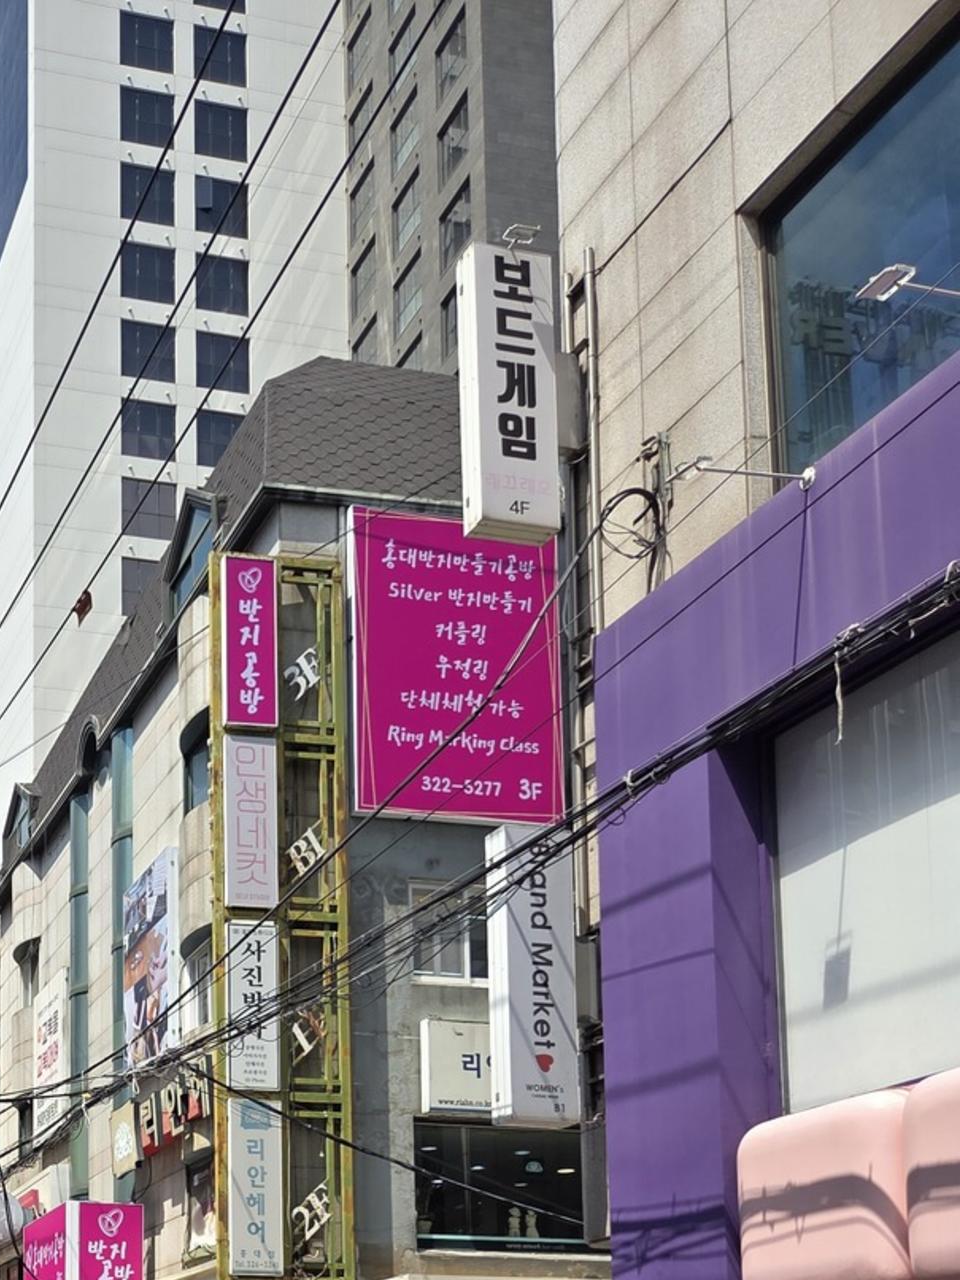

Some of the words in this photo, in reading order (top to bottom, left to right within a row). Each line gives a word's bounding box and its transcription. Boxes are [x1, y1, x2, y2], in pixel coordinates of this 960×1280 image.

[493, 254, 537, 462] 보드게임
[508, 500, 531, 515] 4F
[388, 581, 443, 604] Silver
[447, 587, 533, 614] 반지만들기
[435, 621, 488, 646] 커플링
[239, 598, 264, 715] 반지공방
[435, 655, 489, 681] 우정링
[283, 646, 322, 702] 3F
[489, 698, 524, 719] 가능
[387, 724, 425, 750] Ring
[499, 735, 541, 756] Class
[421, 775, 503, 797] 322-5277
[518, 778, 543, 801] 3F
[234, 745, 270, 887] 인생네컷
[531, 942, 556, 1050] Market
[461, 1053, 492, 1079] 리
[245, 1138, 267, 1245] 리안헤어
[292, 1183, 332, 1241] 2F
[87, 1239, 128, 1260] 반지
